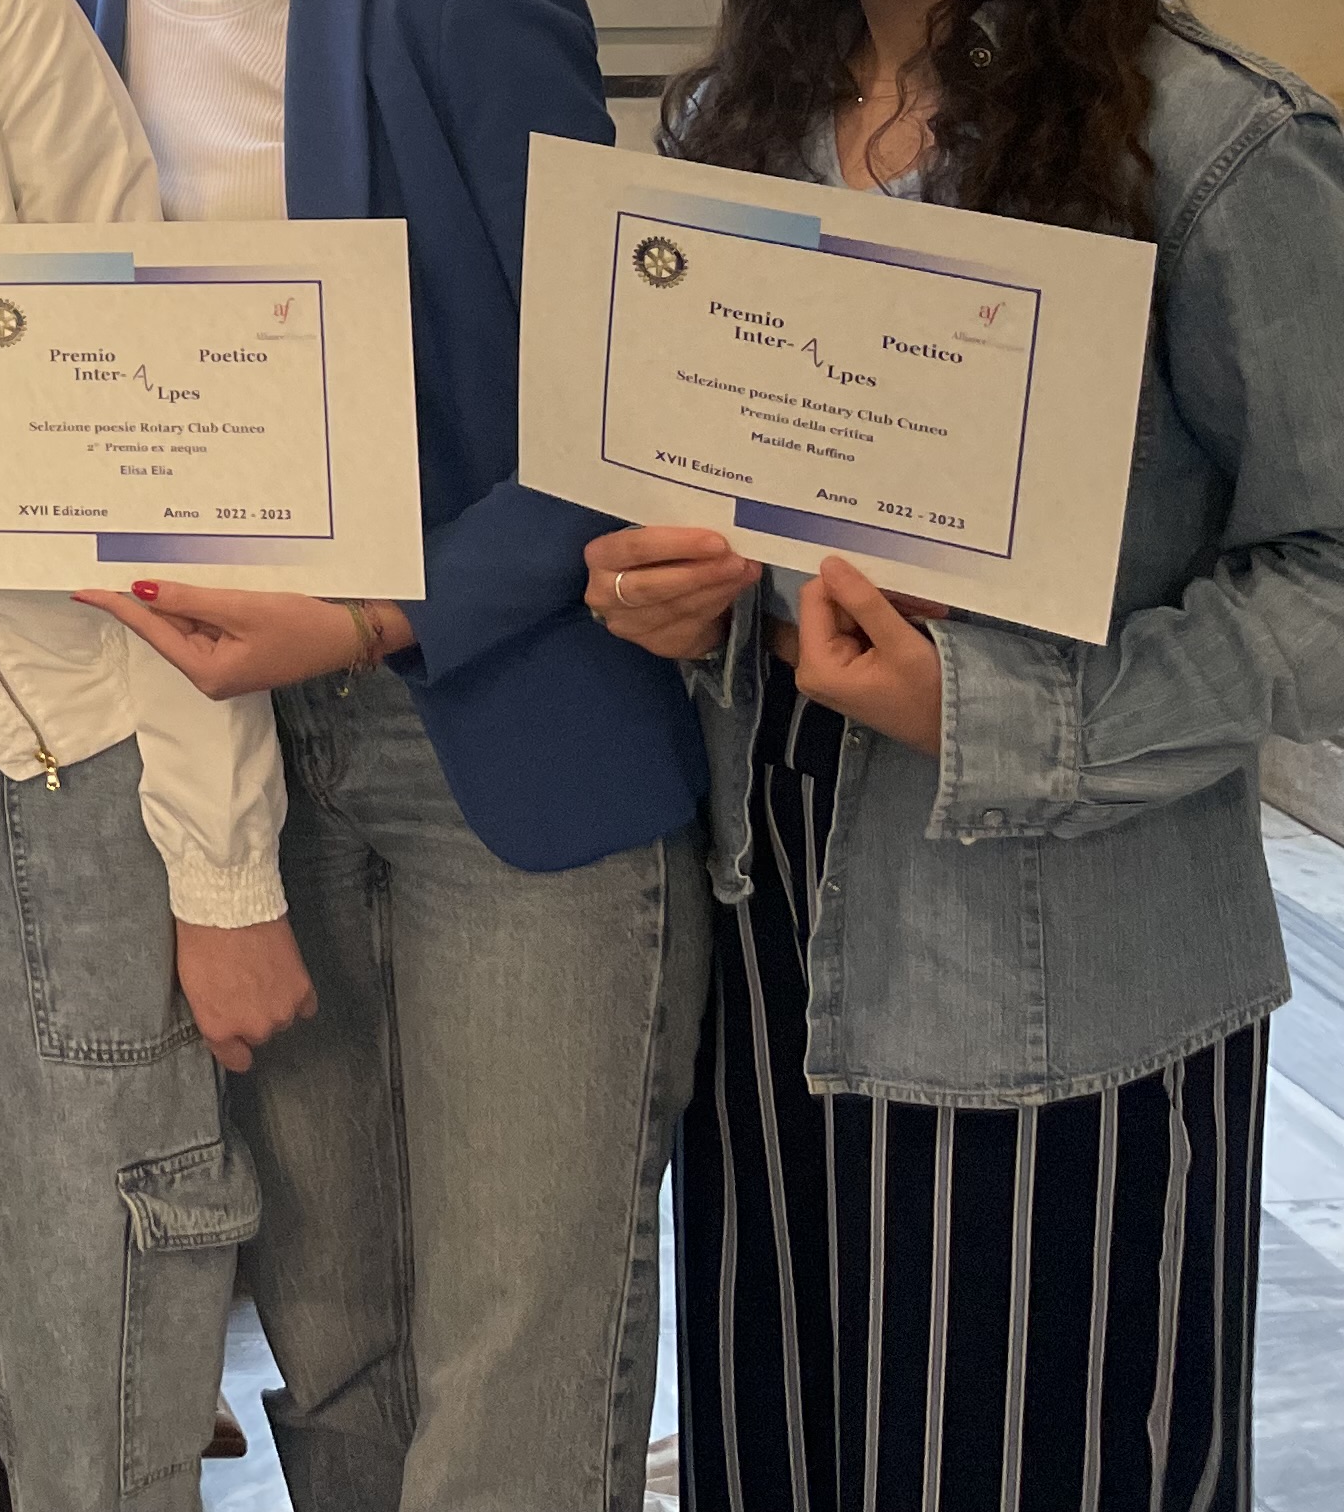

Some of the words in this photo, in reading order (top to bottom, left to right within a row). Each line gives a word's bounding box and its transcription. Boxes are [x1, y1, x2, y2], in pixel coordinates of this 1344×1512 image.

[709, 301, 785, 329] Premio
[882, 335, 963, 365] Poetico
[49, 348, 116, 364] Premio
[199, 349, 268, 364] Poetico
[676, 369, 745, 395] Selezione
[749, 386, 798, 408] poesie
[802, 397, 853, 419] Rotary
[857, 408, 893, 426] Club
[897, 417, 948, 437] Cuneo
[29, 421, 91, 434] Selezione
[94, 421, 136, 435] poesie
[140, 421, 184, 435] Rotary
[188, 421, 219, 434] Club
[222, 423, 265, 434] Cuneo
[740, 405, 790, 425] Premio
[793, 417, 826, 433] della
[830, 423, 874, 442] critica
[105, 442, 148, 453] Premio
[151, 445, 165, 453] ex
[171, 444, 207, 455] aequo
[751, 431, 802, 452] Matilde
[807, 442, 855, 462] Ruffino
[120, 465, 148, 476] Elisa
[151, 465, 173, 476] Elia
[655, 449, 688, 467] XVII
[692, 458, 753, 485] Edizione
[18, 506, 49, 516] XVII
[53, 505, 108, 517] Edizione
[164, 508, 199, 518] Anno
[216, 508, 247, 520] 2022
[260, 509, 292, 520] 2023
[817, 488, 858, 506] Anno
[877, 500, 912, 519] 2022
[929, 512, 965, 530] 2023
